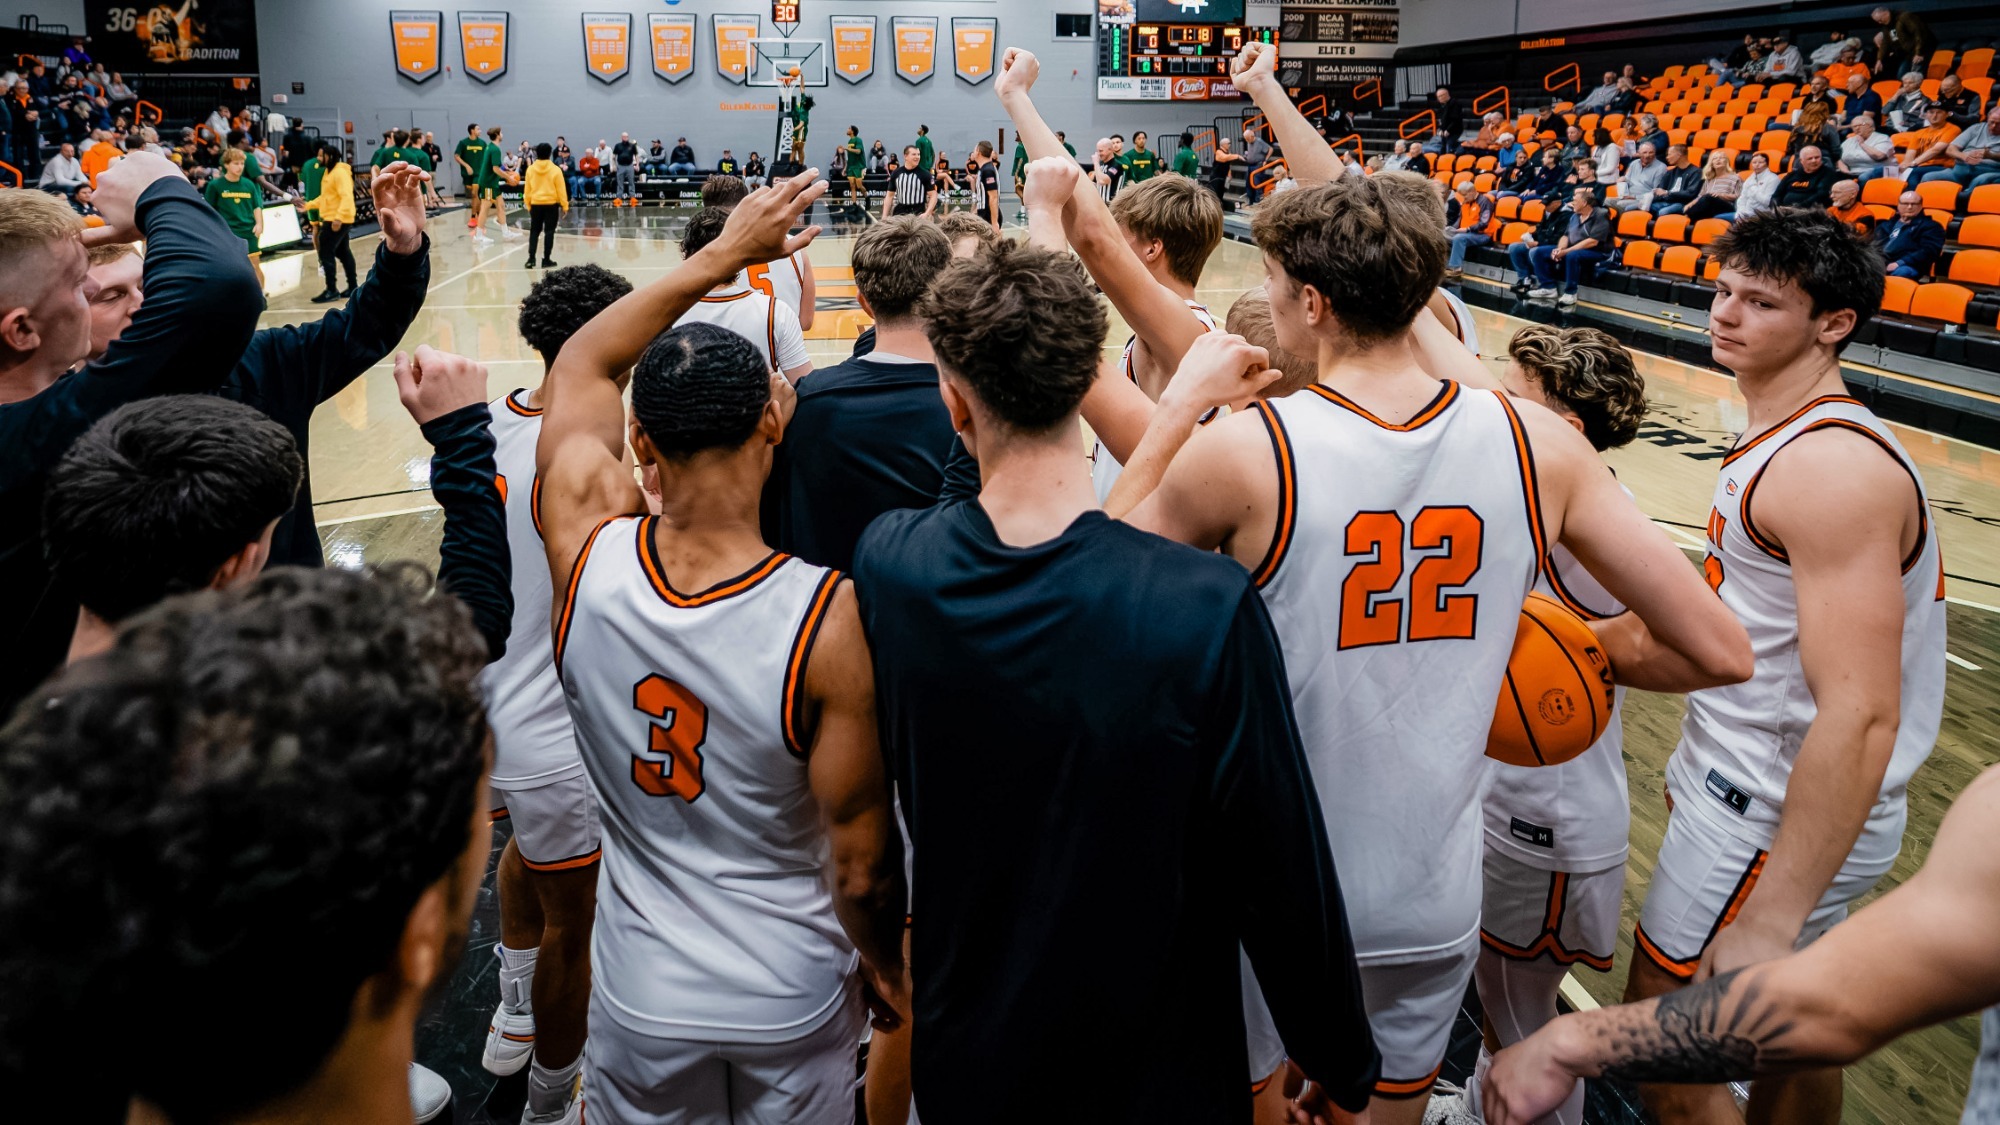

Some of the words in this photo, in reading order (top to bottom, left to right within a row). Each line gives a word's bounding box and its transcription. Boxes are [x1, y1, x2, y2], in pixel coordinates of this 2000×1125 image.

[775, 5, 796, 21] 30
[1283, 14, 1305, 22] 2009
[1318, 14, 1344, 22] NCAA
[1182, 28, 1210, 41] 1:18
[1149, 35, 1158, 48] 0
[1232, 36, 1241, 49] 0
[180, 48, 240, 60] TRADITION
[1318, 46, 1347, 55] ELITE
[1349, 46, 1356, 55] 8
[1282, 61, 1303, 69] 2005
[1316, 65, 1340, 73] NCAA
[1378, 66, 1385, 74] II
[1101, 79, 1132, 89] Plantex
[1175, 79, 1205, 96] Cane's
[747, 262, 775, 298] 5
[1336, 504, 1485, 652] 22
[630, 671, 709, 805] 3
[1731, 793, 1739, 806] L
[1539, 832, 1548, 842] M
